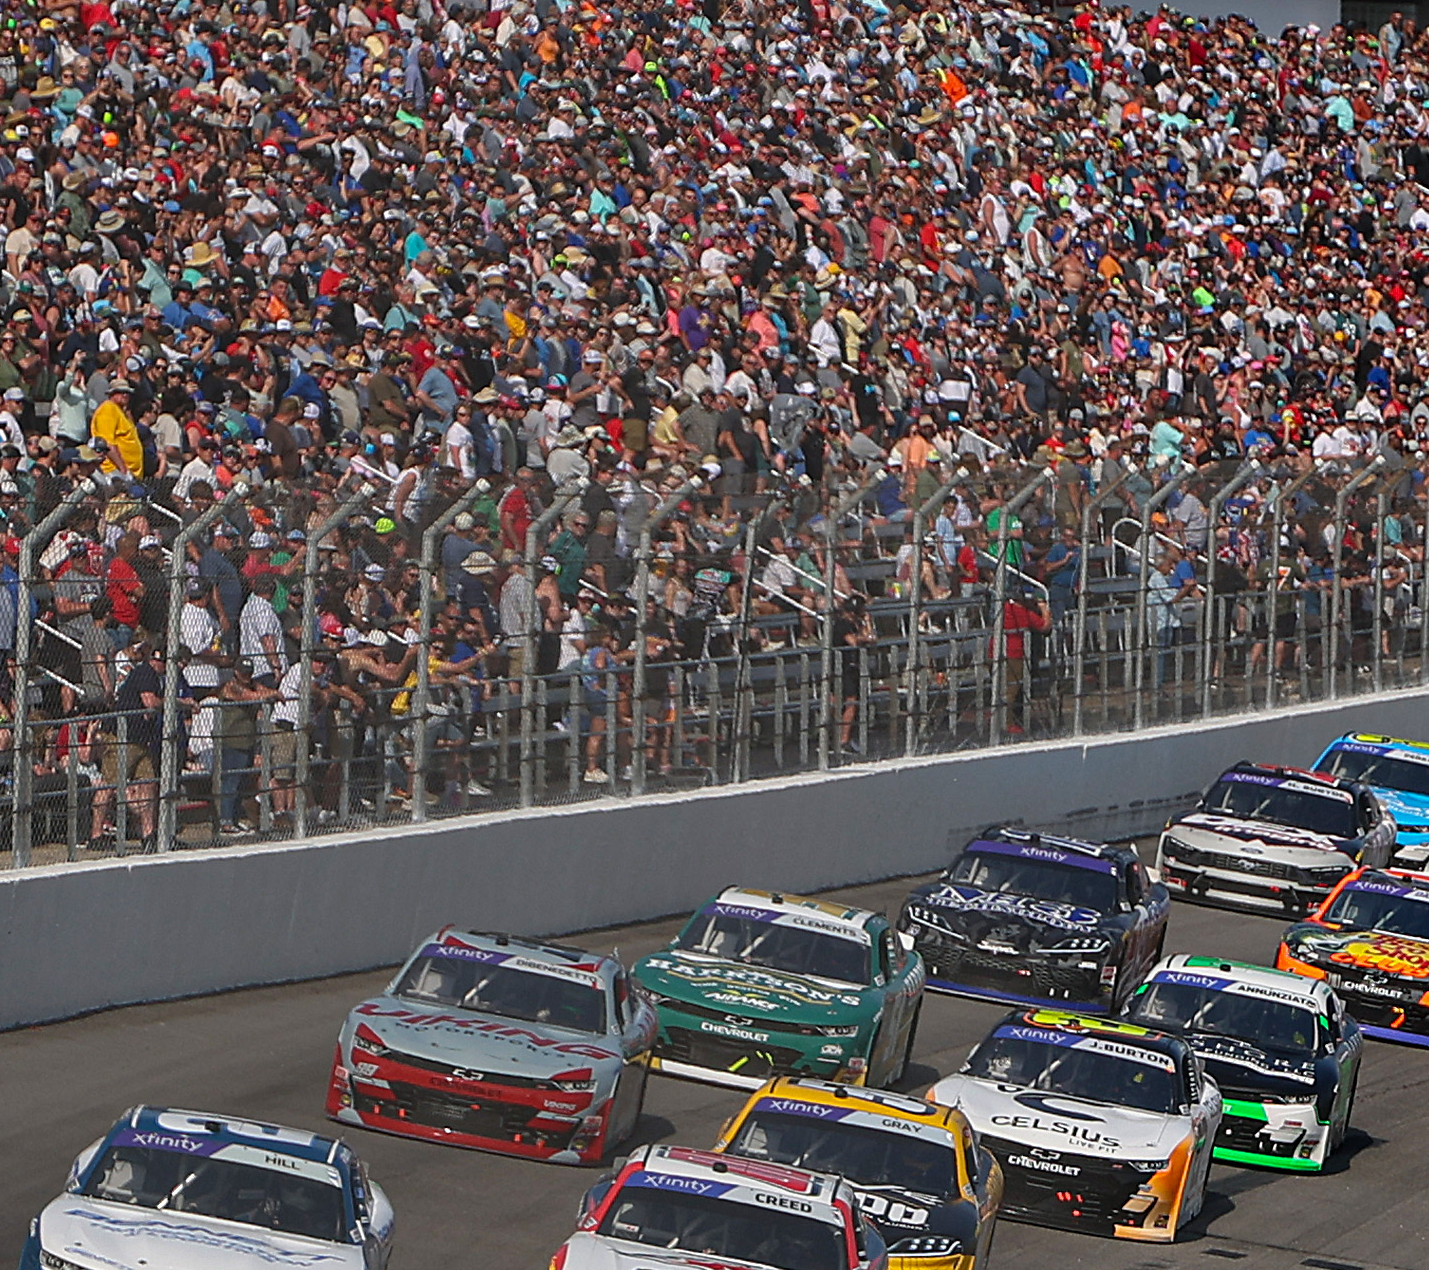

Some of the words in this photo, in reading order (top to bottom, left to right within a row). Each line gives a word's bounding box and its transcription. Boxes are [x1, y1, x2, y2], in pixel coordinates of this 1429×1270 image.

[1020, 845, 1069, 862] xfinity
[1353, 880, 1402, 895] xfinity
[713, 904, 769, 920] xfinity
[434, 946, 494, 962] xfinity
[1165, 972, 1219, 989] xfinity
[1343, 980, 1404, 999] CHEVROLET
[700, 1021, 770, 1042] CHEVROLET
[1010, 1026, 1068, 1045] xfinity
[769, 1099, 833, 1118] xfinity
[881, 1117, 923, 1134] GRAY
[991, 1114, 1121, 1149] CELSIUS
[131, 1131, 205, 1153] xfinity
[264, 1154, 301, 1171] HILL
[1007, 1154, 1082, 1177] CHEVROLET
[643, 1174, 713, 1194] xfinity
[754, 1192, 813, 1214] CREED
